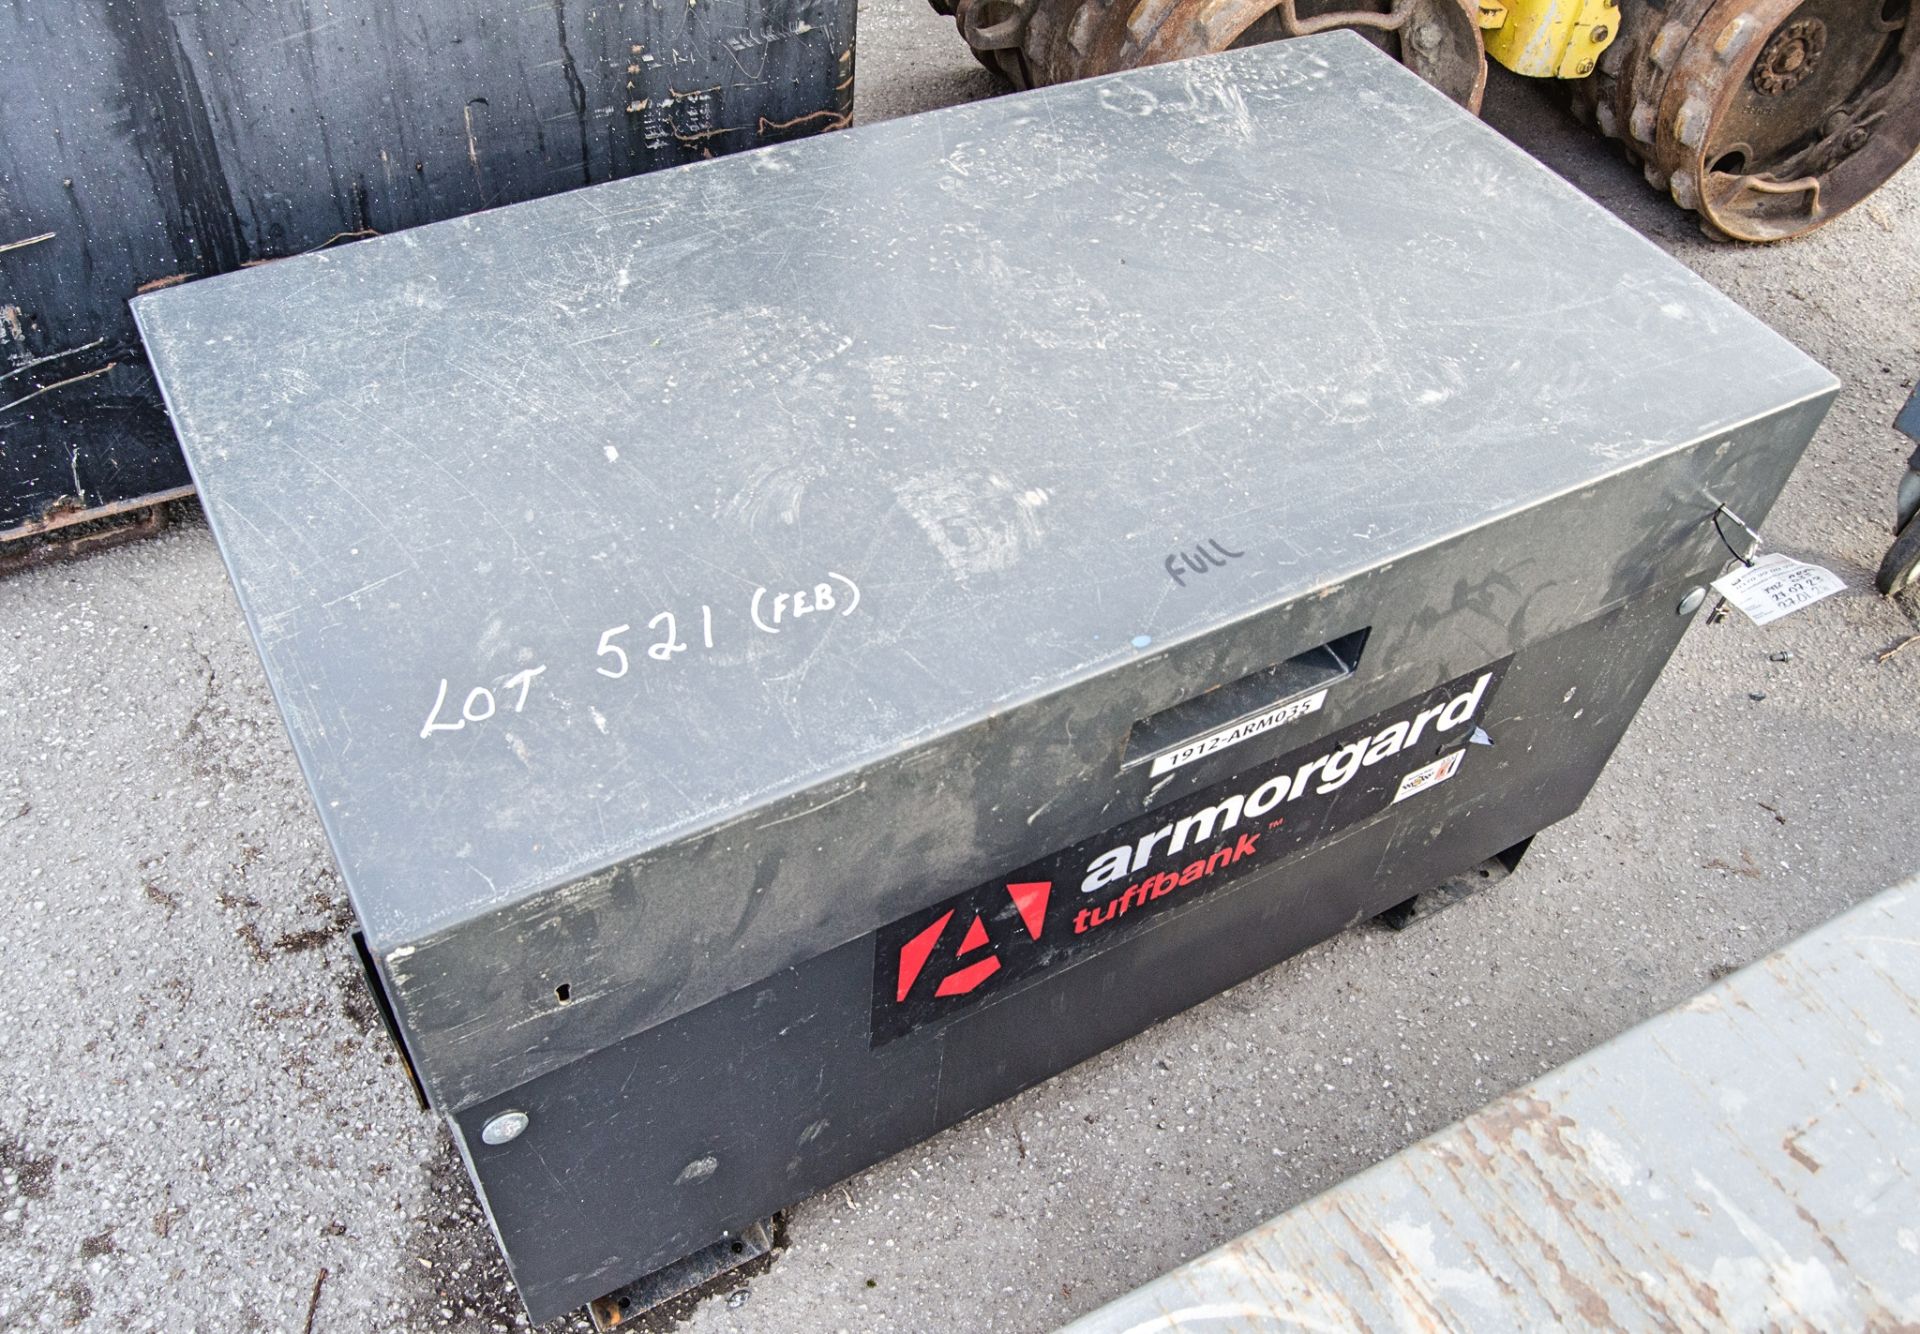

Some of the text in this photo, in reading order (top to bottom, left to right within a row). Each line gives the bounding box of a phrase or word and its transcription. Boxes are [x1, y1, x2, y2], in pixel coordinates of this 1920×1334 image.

[1165, 538, 1245, 587] FULL
[420, 572, 860, 739] LOT 521 (FEB)
[1081, 672, 1493, 893] armorgard
[1170, 700, 1312, 766] 1912-ARM035
[1073, 833, 1261, 934] tuffbank
